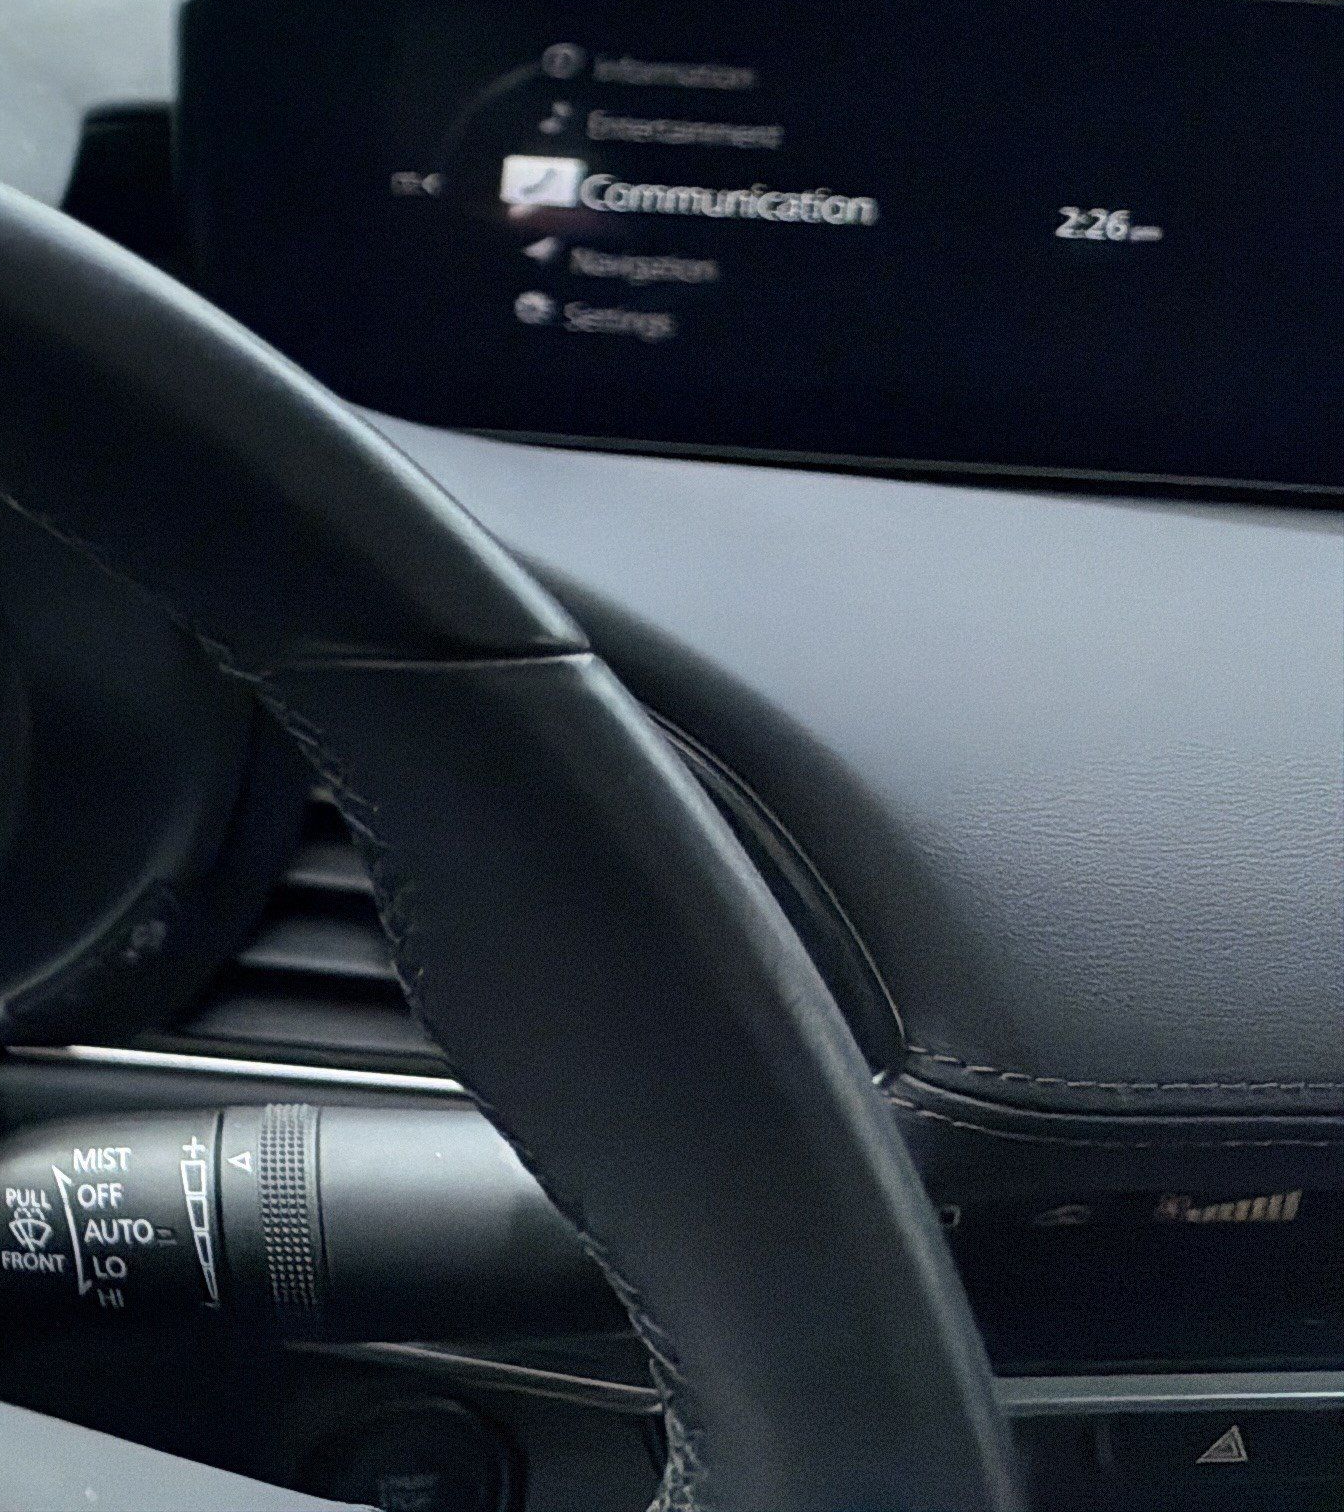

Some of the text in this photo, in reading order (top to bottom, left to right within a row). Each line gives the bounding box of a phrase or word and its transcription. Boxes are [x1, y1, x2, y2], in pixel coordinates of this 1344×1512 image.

[580, 173, 880, 226] Communication
[73, 1148, 132, 1172] MIST
[6, 1188, 52, 1211] PULL
[77, 1184, 123, 1209] OFF
[84, 1219, 154, 1245] AUTO
[2, 1251, 65, 1274] FRONT
[92, 1256, 127, 1279] LO
[98, 1287, 125, 1308] HI
